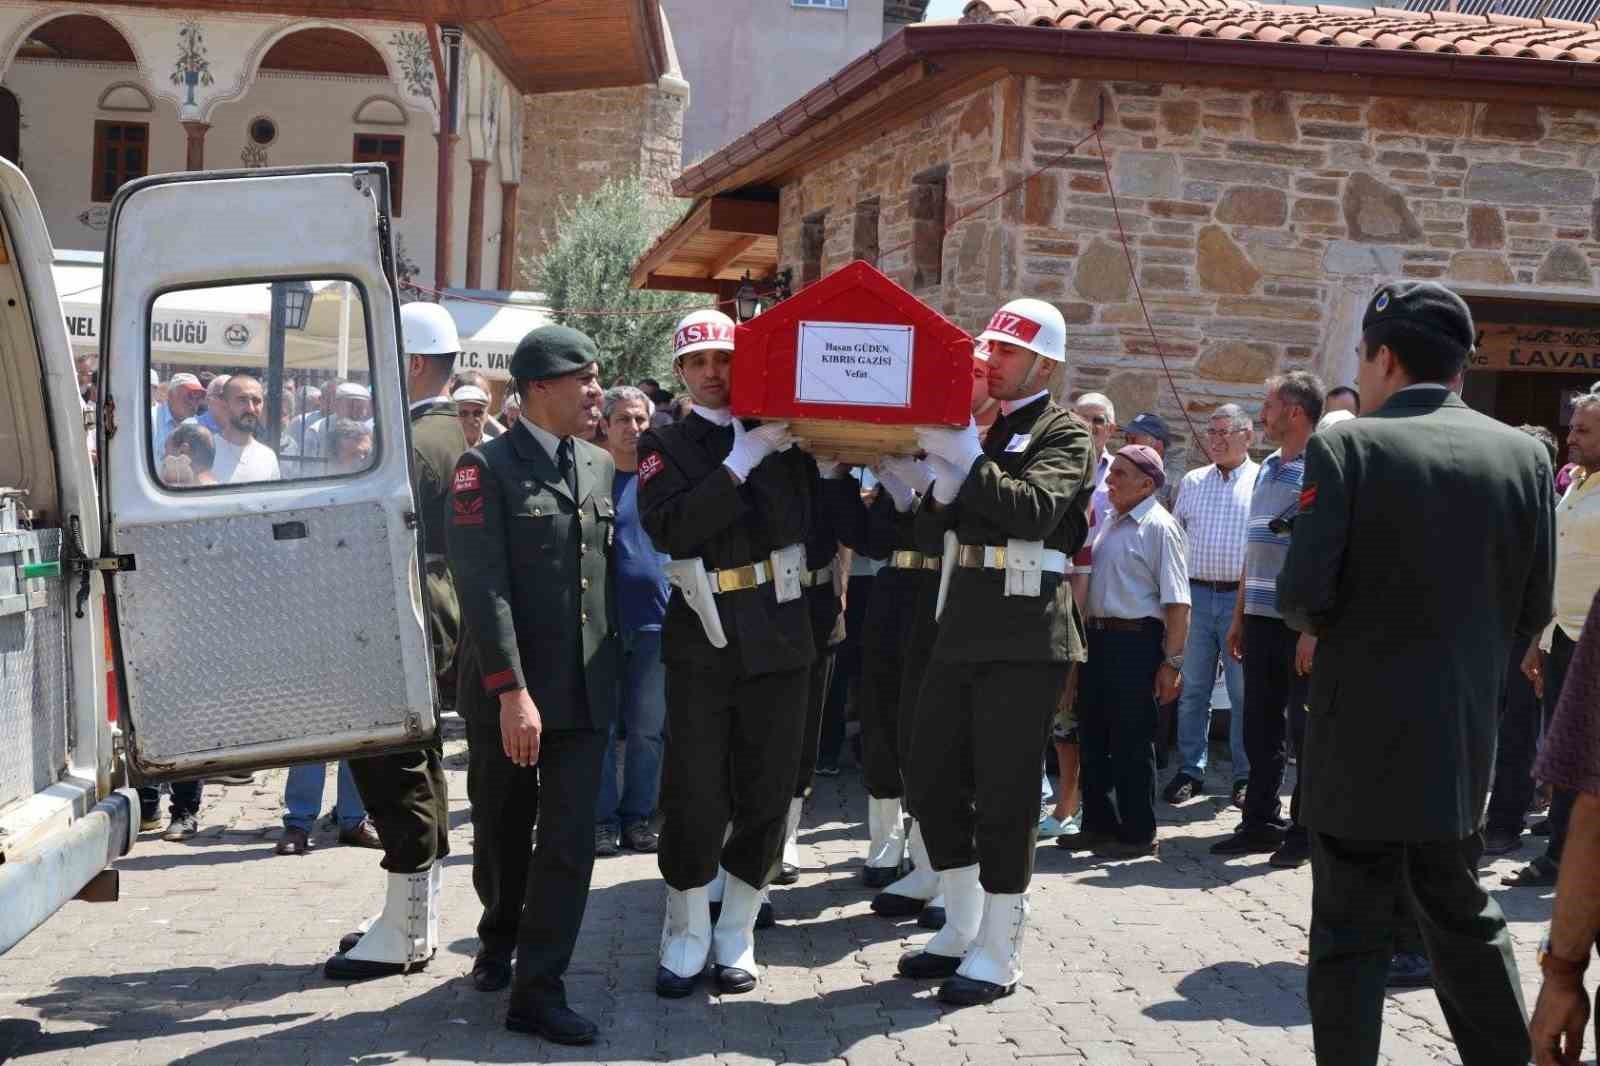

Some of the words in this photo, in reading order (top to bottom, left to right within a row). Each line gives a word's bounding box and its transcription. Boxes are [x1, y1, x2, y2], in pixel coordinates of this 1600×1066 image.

[825, 342, 852, 352] Hasan
[854, 342, 889, 354] GÜDEN
[460, 352, 482, 368] T.C.
[822, 354, 856, 364] KIBRIS
